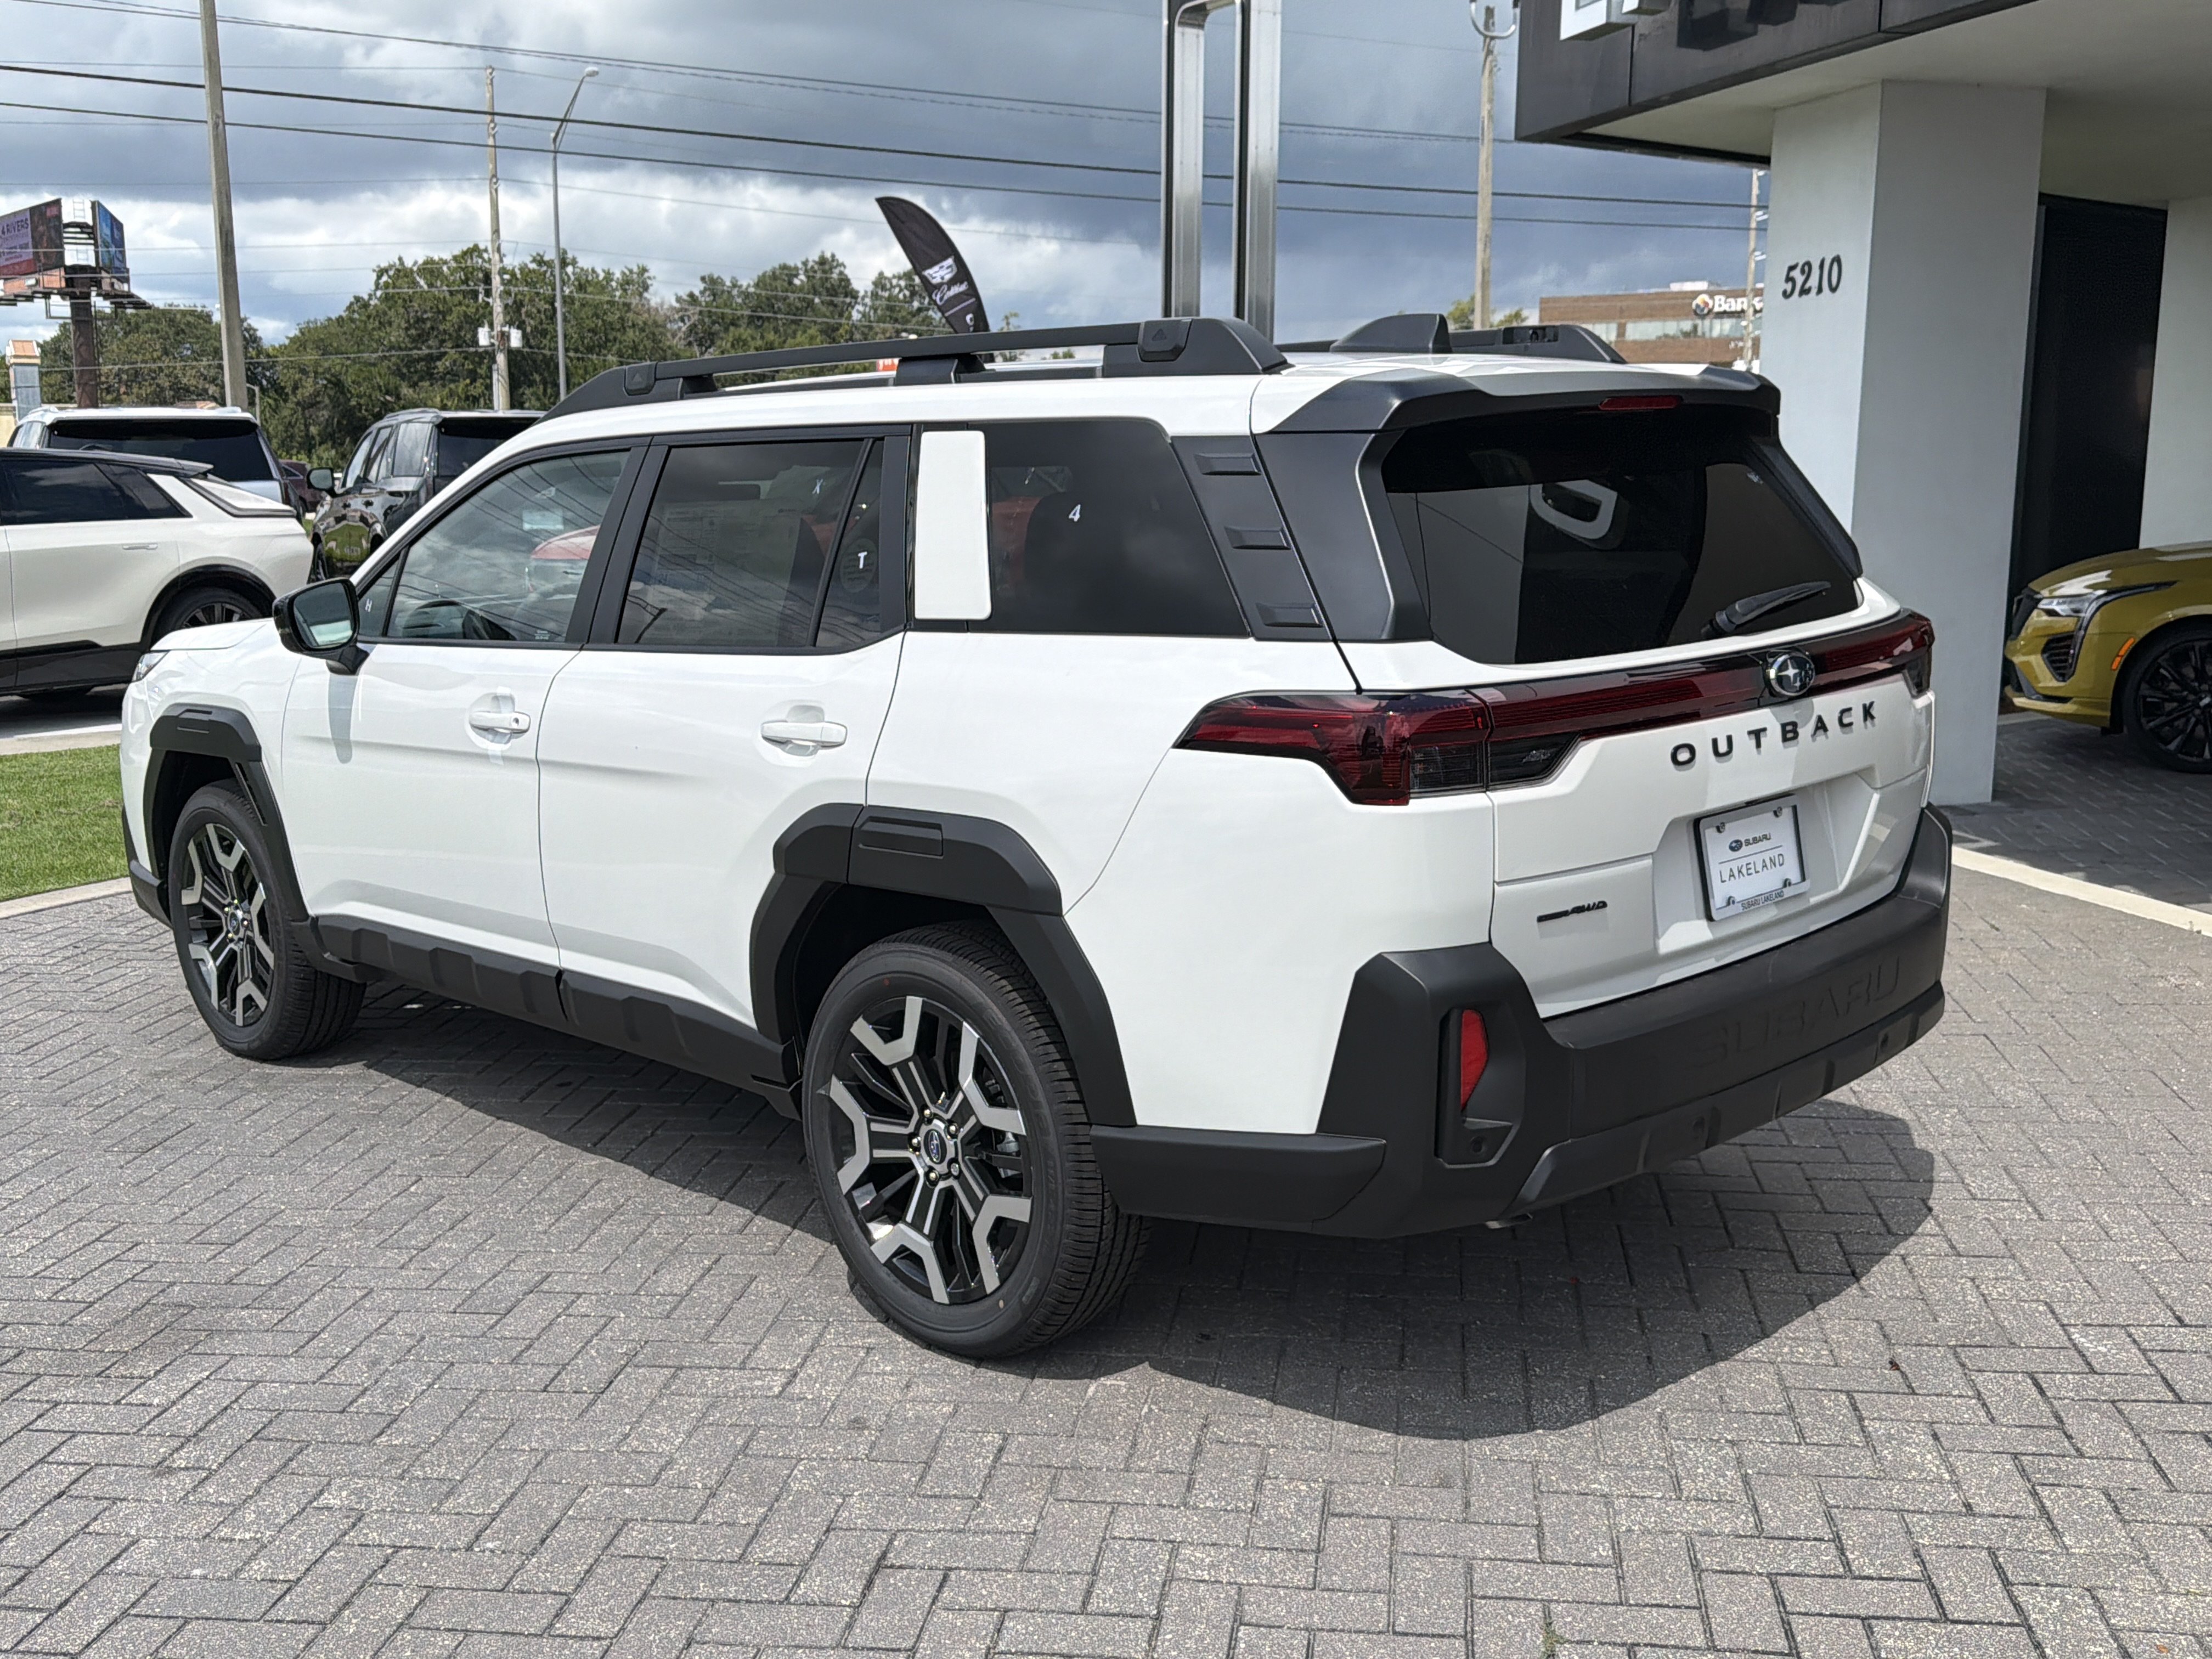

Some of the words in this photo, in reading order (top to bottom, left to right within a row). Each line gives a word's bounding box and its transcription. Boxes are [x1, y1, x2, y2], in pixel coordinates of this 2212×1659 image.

[1782, 254, 1842, 299] 5210
[1671, 701, 1877, 766] OUTBACK
[1743, 832, 1771, 847] SUBARU
[1719, 853, 1785, 884] LAKELAND
[1741, 899, 1760, 911] SUBARU
[1761, 890, 1785, 905] LAKELAND
